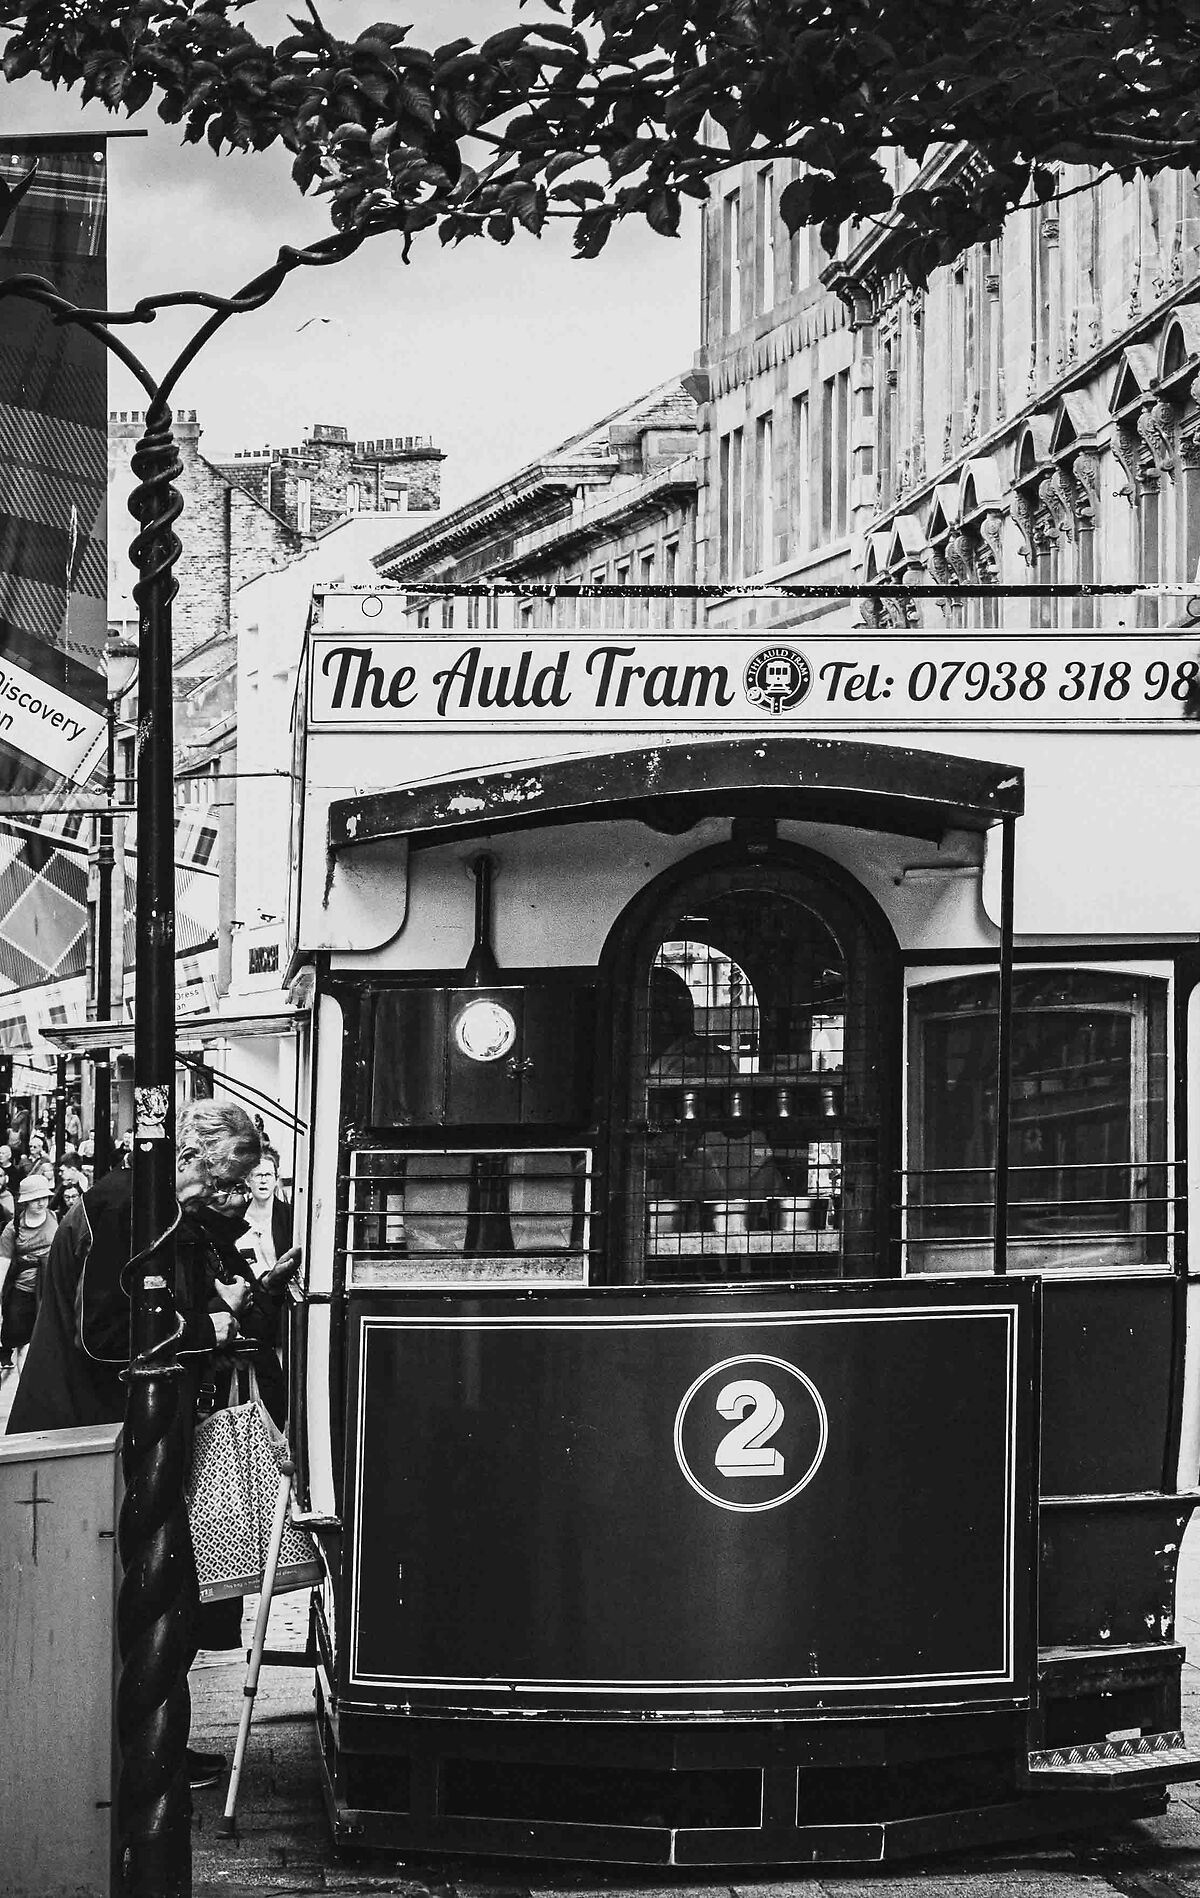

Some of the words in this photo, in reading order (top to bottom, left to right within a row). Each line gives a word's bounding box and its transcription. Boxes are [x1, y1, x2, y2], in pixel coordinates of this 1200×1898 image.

[322, 646, 418, 709] The
[432, 646, 572, 716] Auld
[585, 646, 736, 708] Tram
[748, 656, 764, 675] THE
[763, 649, 789, 660] AULD
[790, 653, 809, 676] TRAM
[819, 661, 895, 702] Tel:
[908, 661, 1048, 702] 07938
[1059, 661, 1132, 702] 318
[715, 1379, 785, 1478] 2
